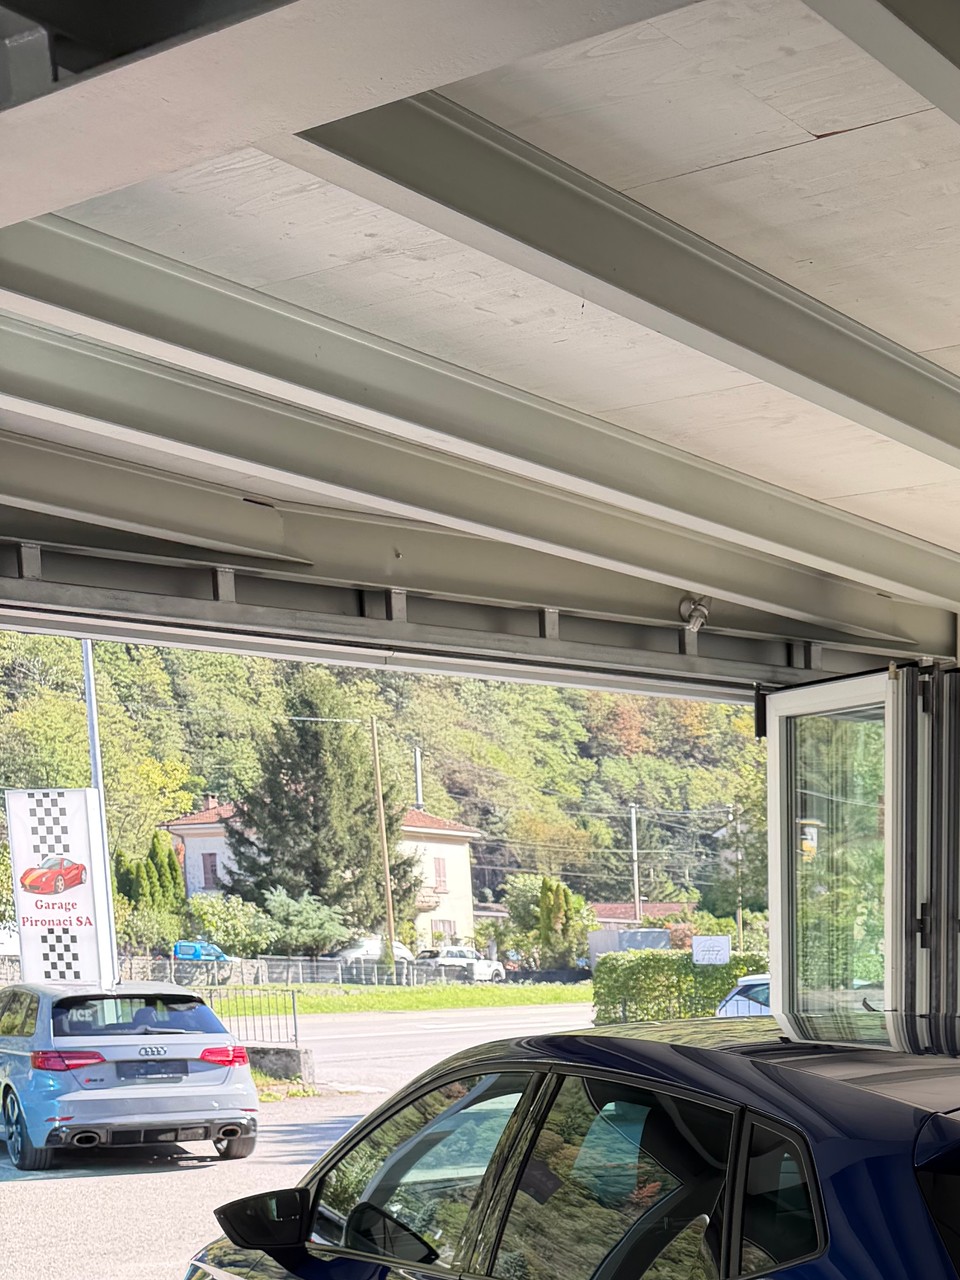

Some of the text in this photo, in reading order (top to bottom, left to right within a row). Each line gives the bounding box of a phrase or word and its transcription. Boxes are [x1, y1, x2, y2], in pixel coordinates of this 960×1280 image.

[35, 899, 78, 912] Garage
[21, 916, 93, 927] Pironaci SA
